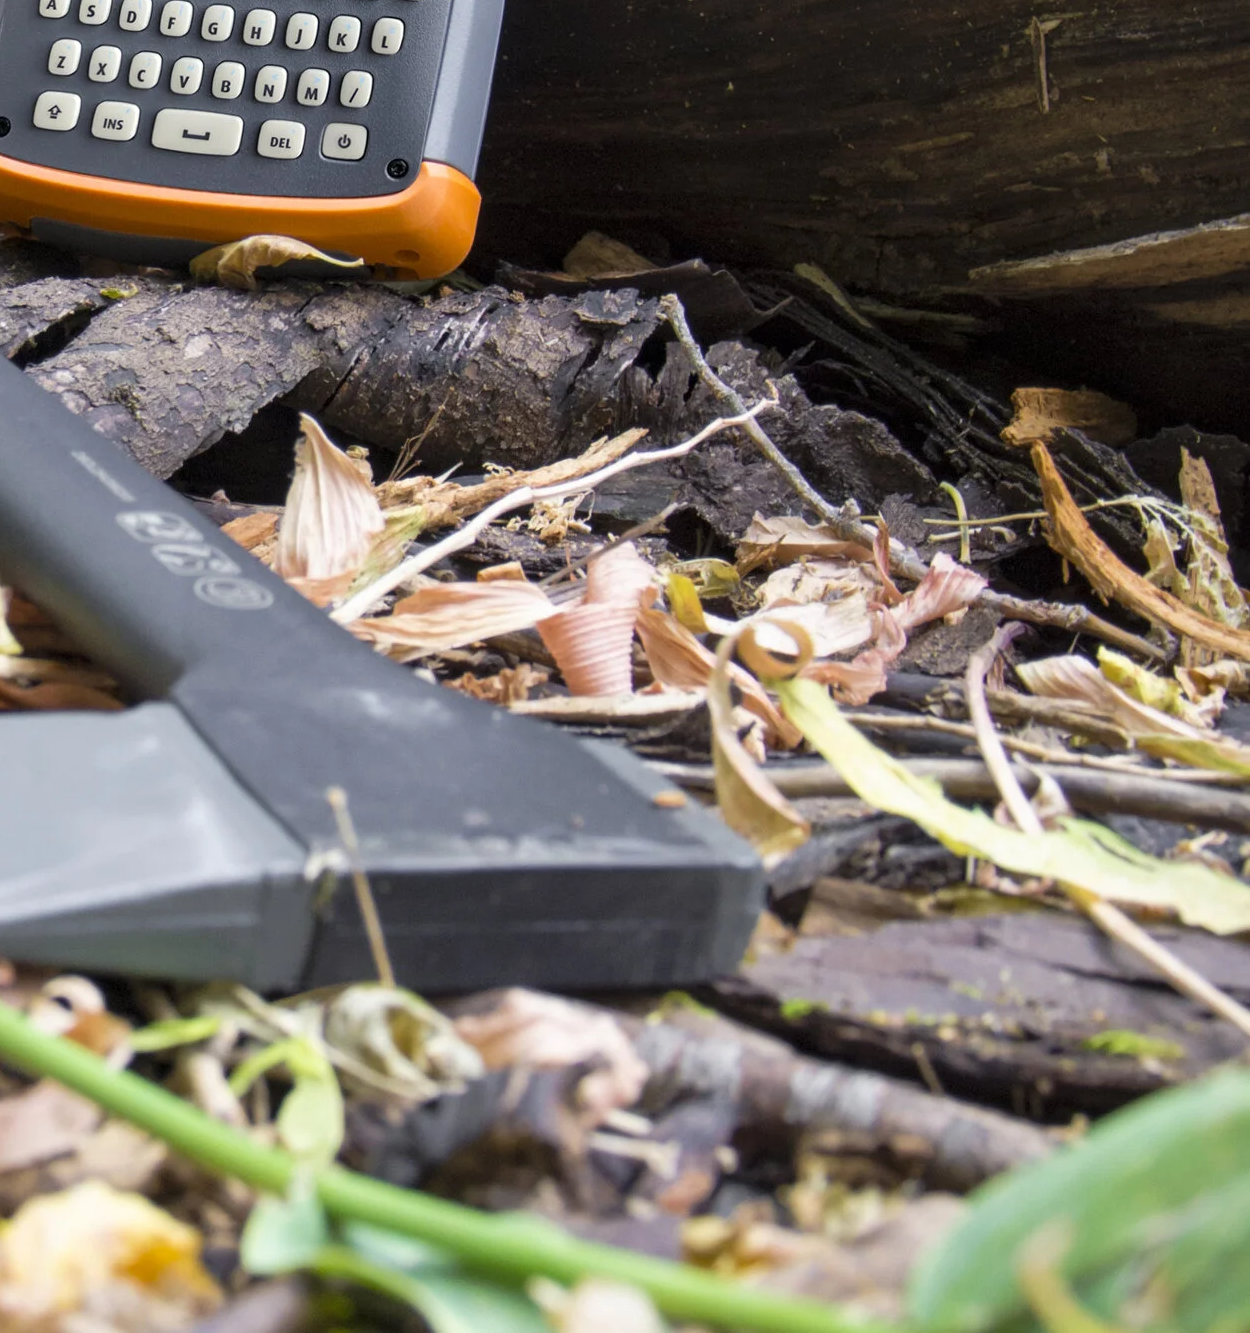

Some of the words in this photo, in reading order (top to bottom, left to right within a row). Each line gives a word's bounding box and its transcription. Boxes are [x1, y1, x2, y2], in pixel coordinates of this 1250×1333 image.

[86, 4, 96, 18] S
[126, 10, 137, 24] D
[167, 16, 176, 30] F
[208, 22, 218, 36] G
[250, 26, 262, 40] H
[294, 28, 303, 45] J
[336, 33, 347, 47] K
[381, 35, 388, 49] L
[56, 55, 66, 69] Z
[96, 62, 107, 76] X
[137, 69, 146, 83] C
[179, 75, 190, 89] V
[220, 80, 231, 93] B
[262, 84, 275, 98] N
[304, 87, 318, 101] M
[103, 118, 124, 131] INS
[269, 136, 291, 149] DEL
